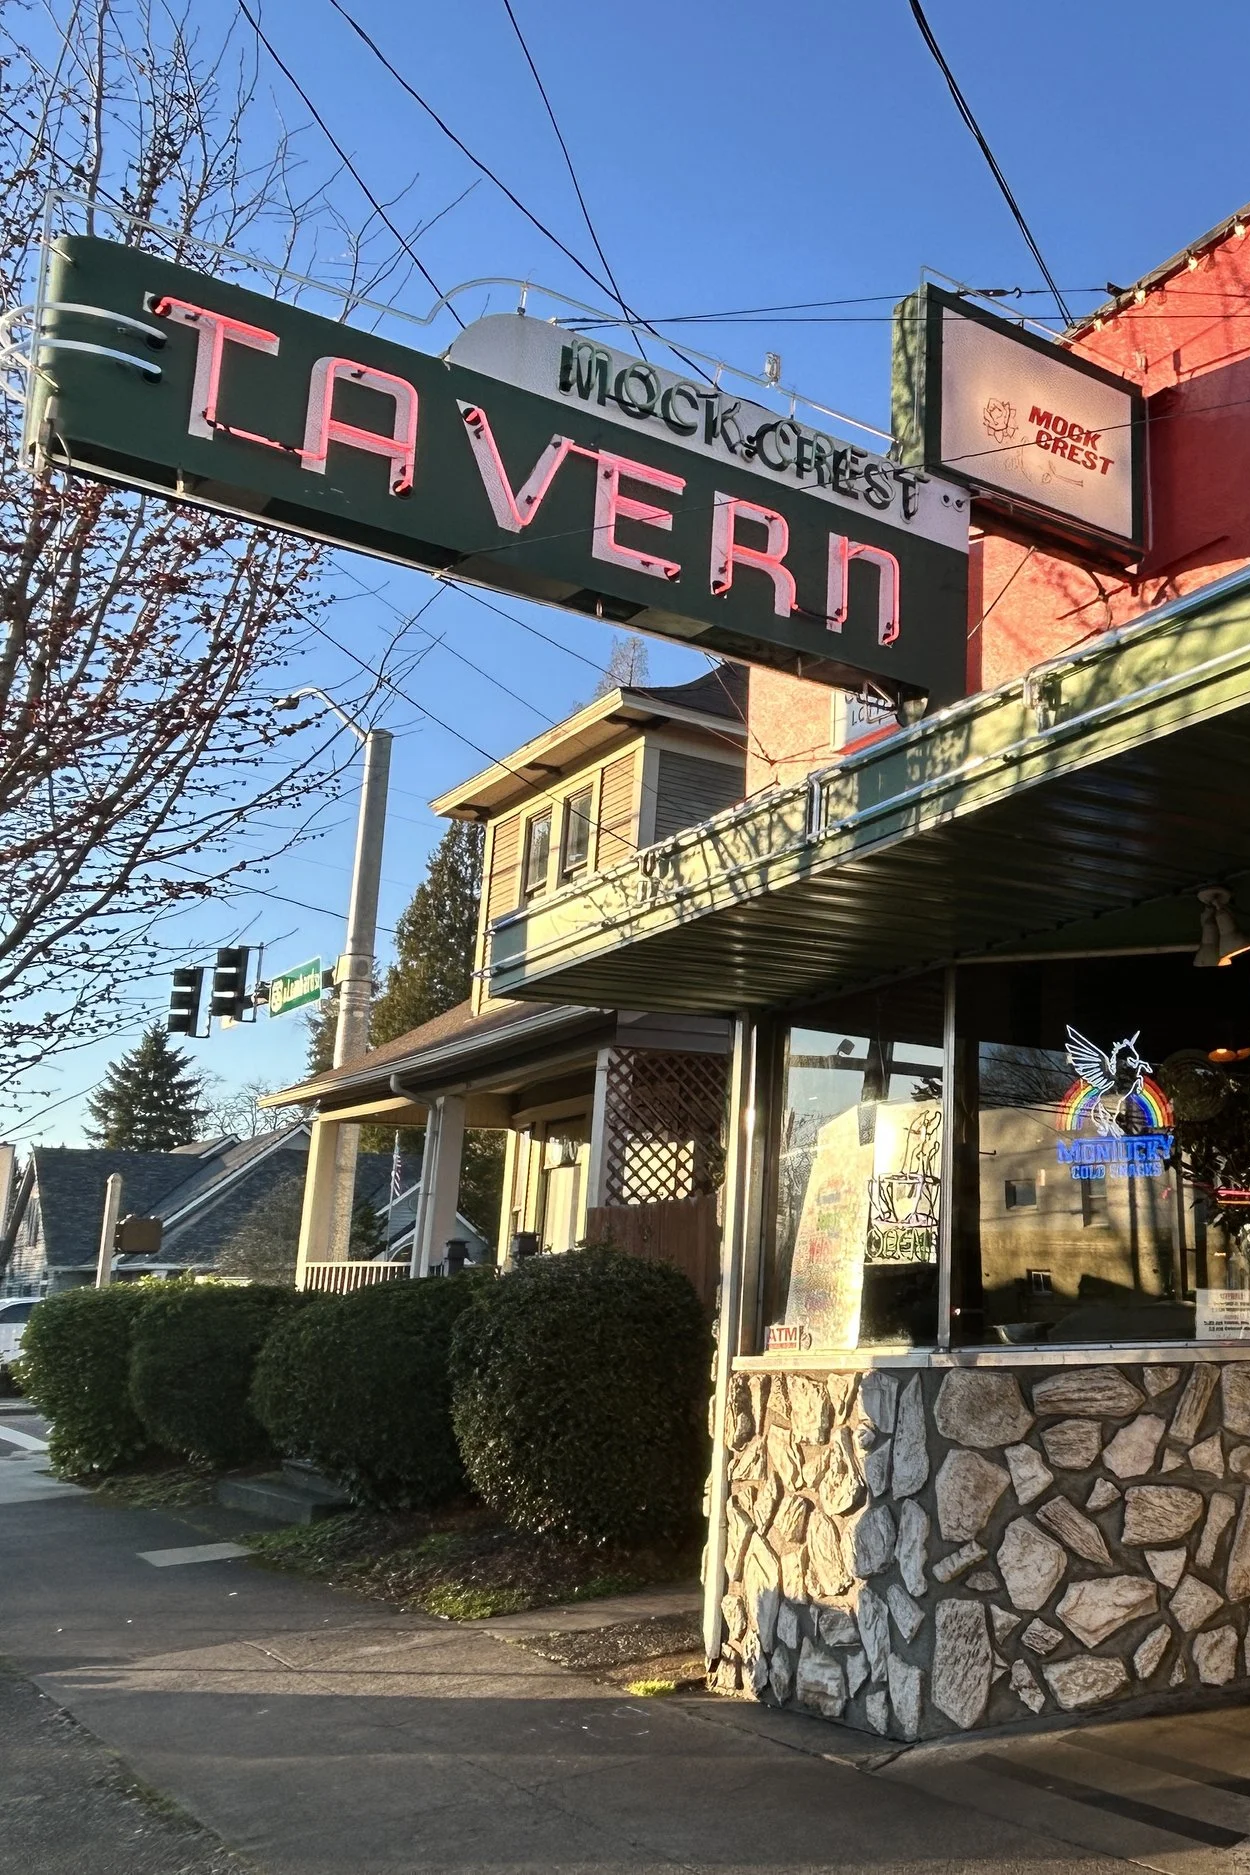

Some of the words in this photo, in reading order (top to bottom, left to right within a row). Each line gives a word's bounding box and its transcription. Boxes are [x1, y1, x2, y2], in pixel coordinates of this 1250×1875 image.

[558, 339, 743, 455] MOCK
[750, 419, 930, 524] CREST
[1028, 405, 1102, 451] MOCK
[1036, 430, 1115, 475] CREST
[1056, 1133, 1175, 1164] MONTUCKY
[1070, 1163, 1106, 1180] COLD
[1109, 1161, 1163, 1179] SNACKS
[768, 1326, 798, 1343] ATM
